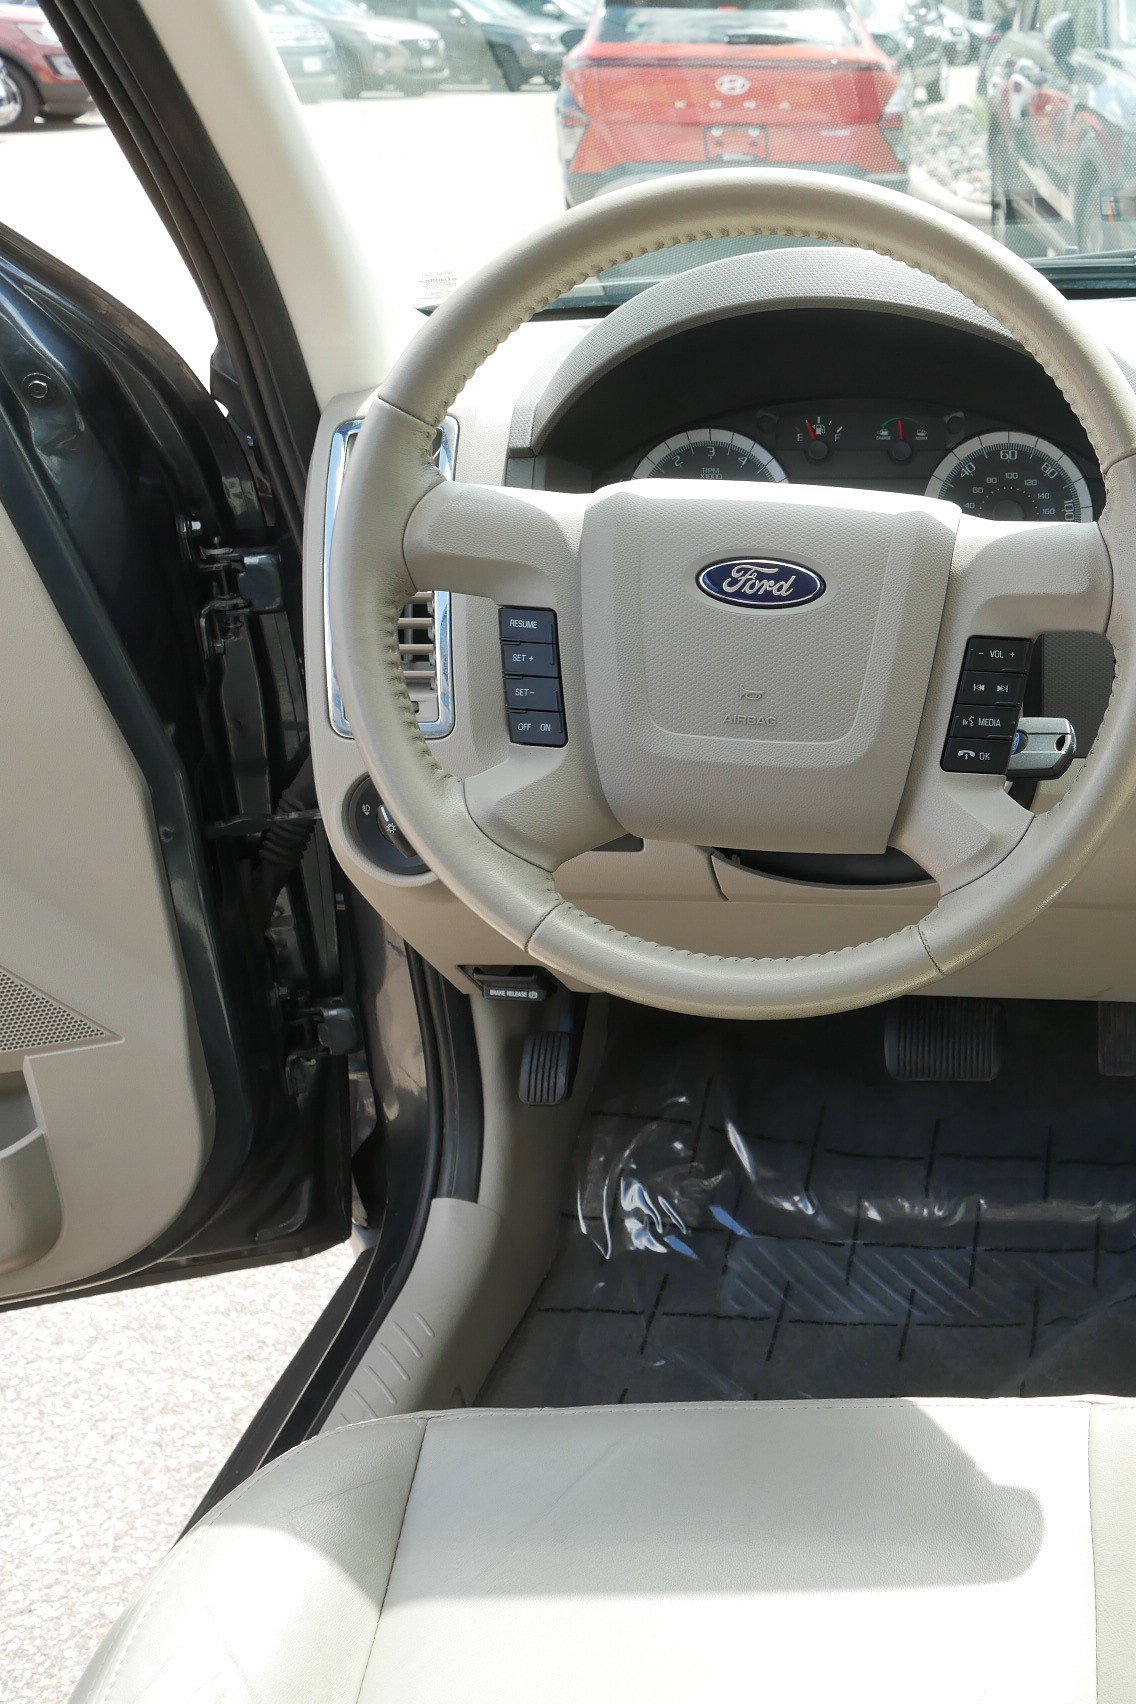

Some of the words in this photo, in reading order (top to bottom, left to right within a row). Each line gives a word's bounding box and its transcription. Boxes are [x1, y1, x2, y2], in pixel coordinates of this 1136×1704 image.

[797, 434, 803, 442] E
[835, 433, 841, 442] F
[707, 446, 715, 457] 3
[1000, 449, 1018, 460] 60
[672, 455, 682, 467] 2
[738, 454, 748, 465] 4
[960, 462, 976, 478] 40
[1041, 462, 1058, 479] 80
[722, 564, 796, 597] Ford
[509, 619, 538, 629] RESUME
[512, 654, 526, 662] SET
[989, 650, 1004, 658] VOL
[515, 688, 529, 697] SET
[722, 713, 778, 727] AIRBAG
[978, 718, 1001, 727] MEDIA
[518, 723, 532, 731] OFF
[979, 752, 990, 761] OK
[506, 990, 528, 998] RELEASE
